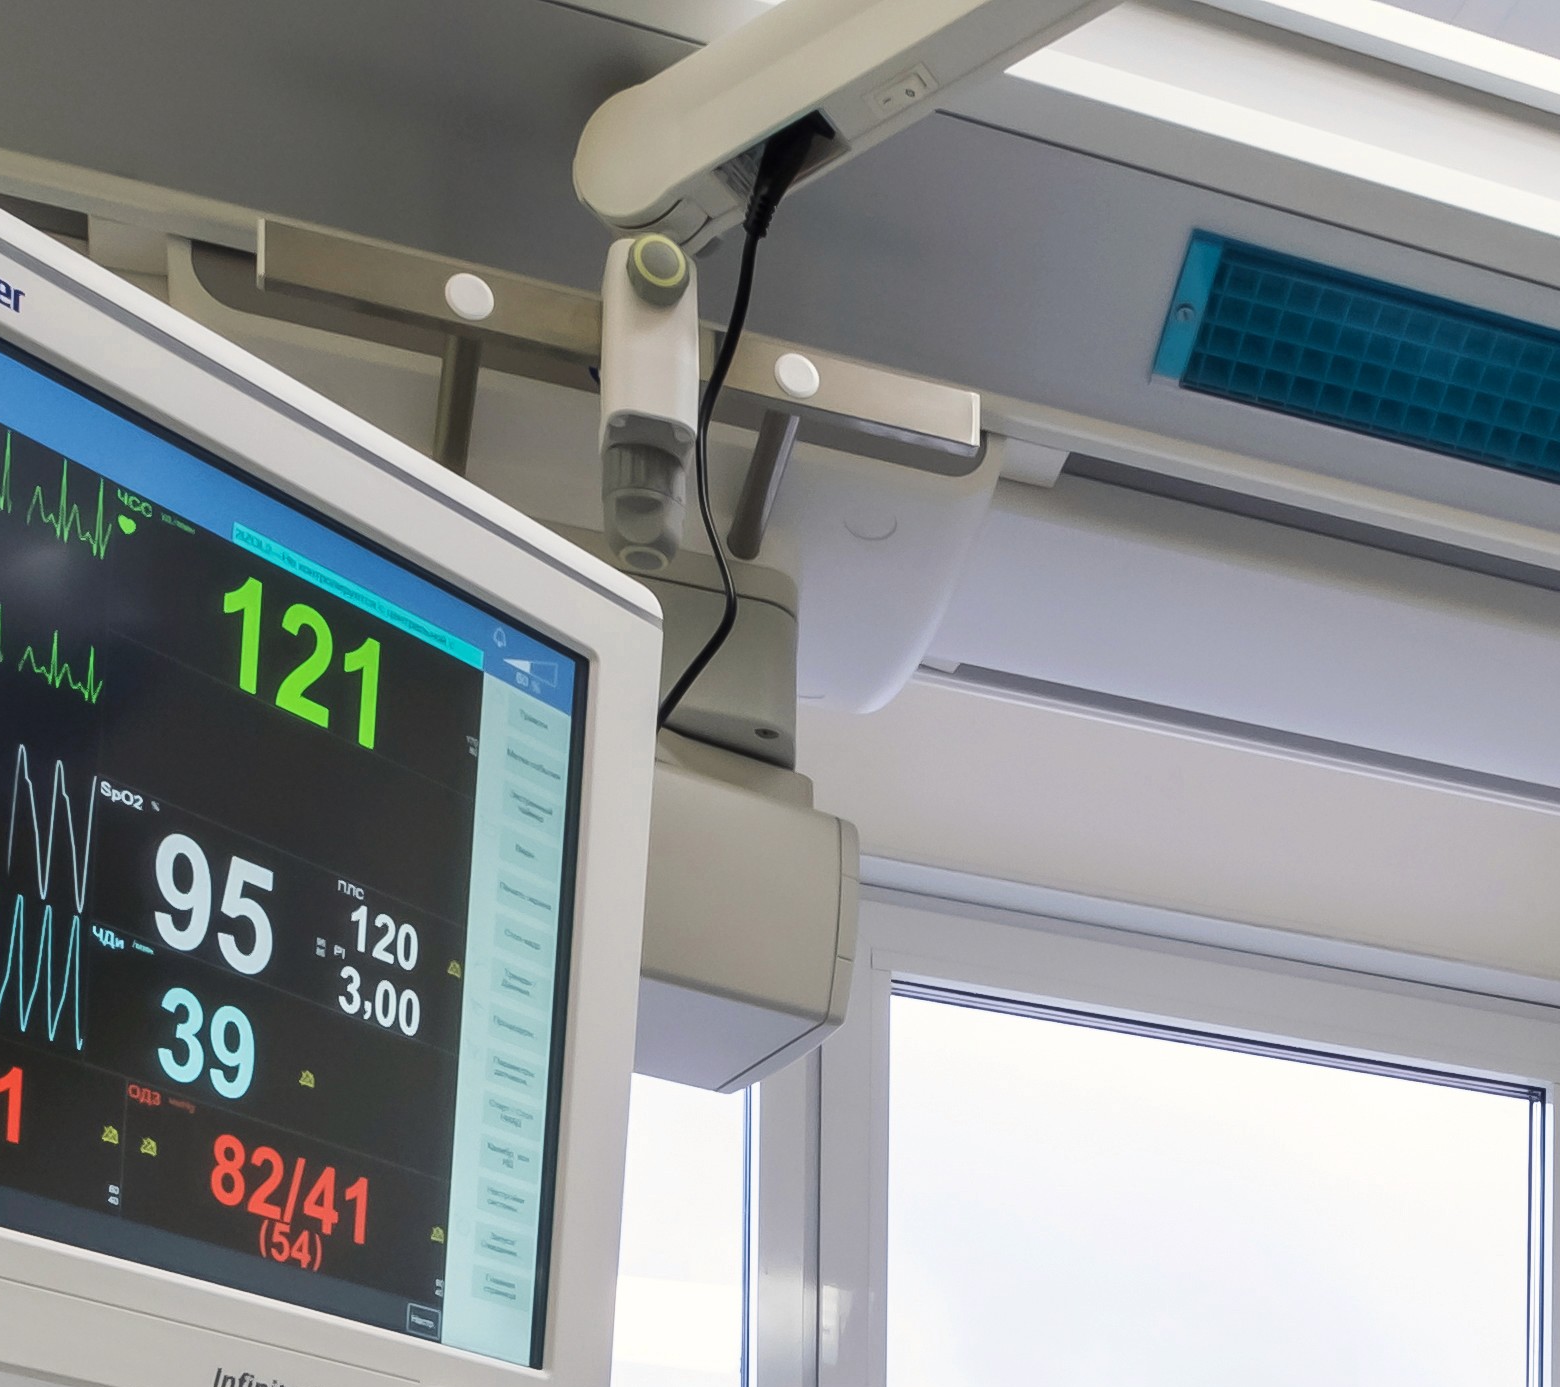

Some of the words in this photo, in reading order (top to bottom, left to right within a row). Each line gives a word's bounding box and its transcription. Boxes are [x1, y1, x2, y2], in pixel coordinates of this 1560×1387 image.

[222, 576, 381, 751] 121
[99, 780, 145, 812] SpO2
[92, 924, 125, 951] ЧДи
[154, 832, 275, 976] 95
[350, 904, 419, 971] 120
[338, 965, 421, 1038] 3,00
[156, 986, 256, 1099] 39
[127, 1081, 162, 1108] ОД3
[210, 1132, 370, 1247] 82/41
[258, 1218, 324, 1273] (54)
